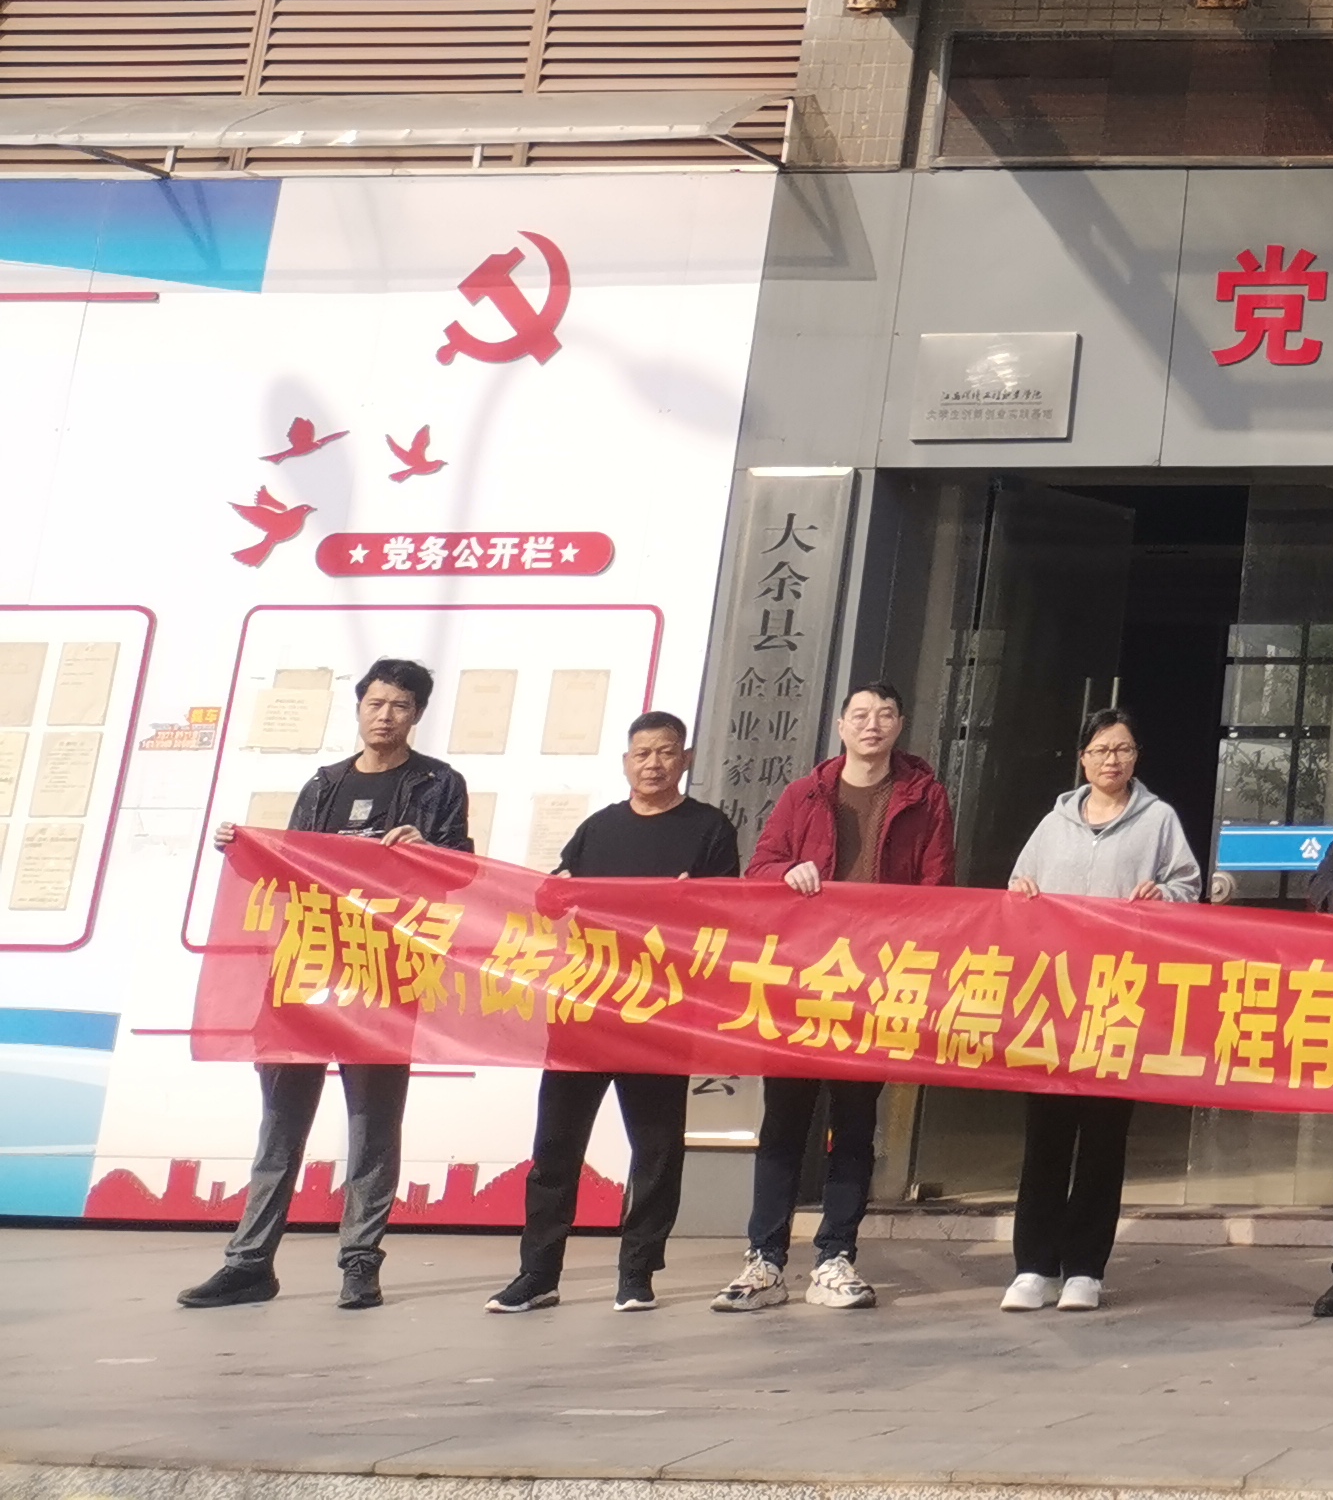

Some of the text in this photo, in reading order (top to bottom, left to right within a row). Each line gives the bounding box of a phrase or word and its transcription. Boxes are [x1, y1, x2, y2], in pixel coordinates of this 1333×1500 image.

[381, 536, 555, 570] 党务公开栏
[748, 512, 819, 652] 大余县
